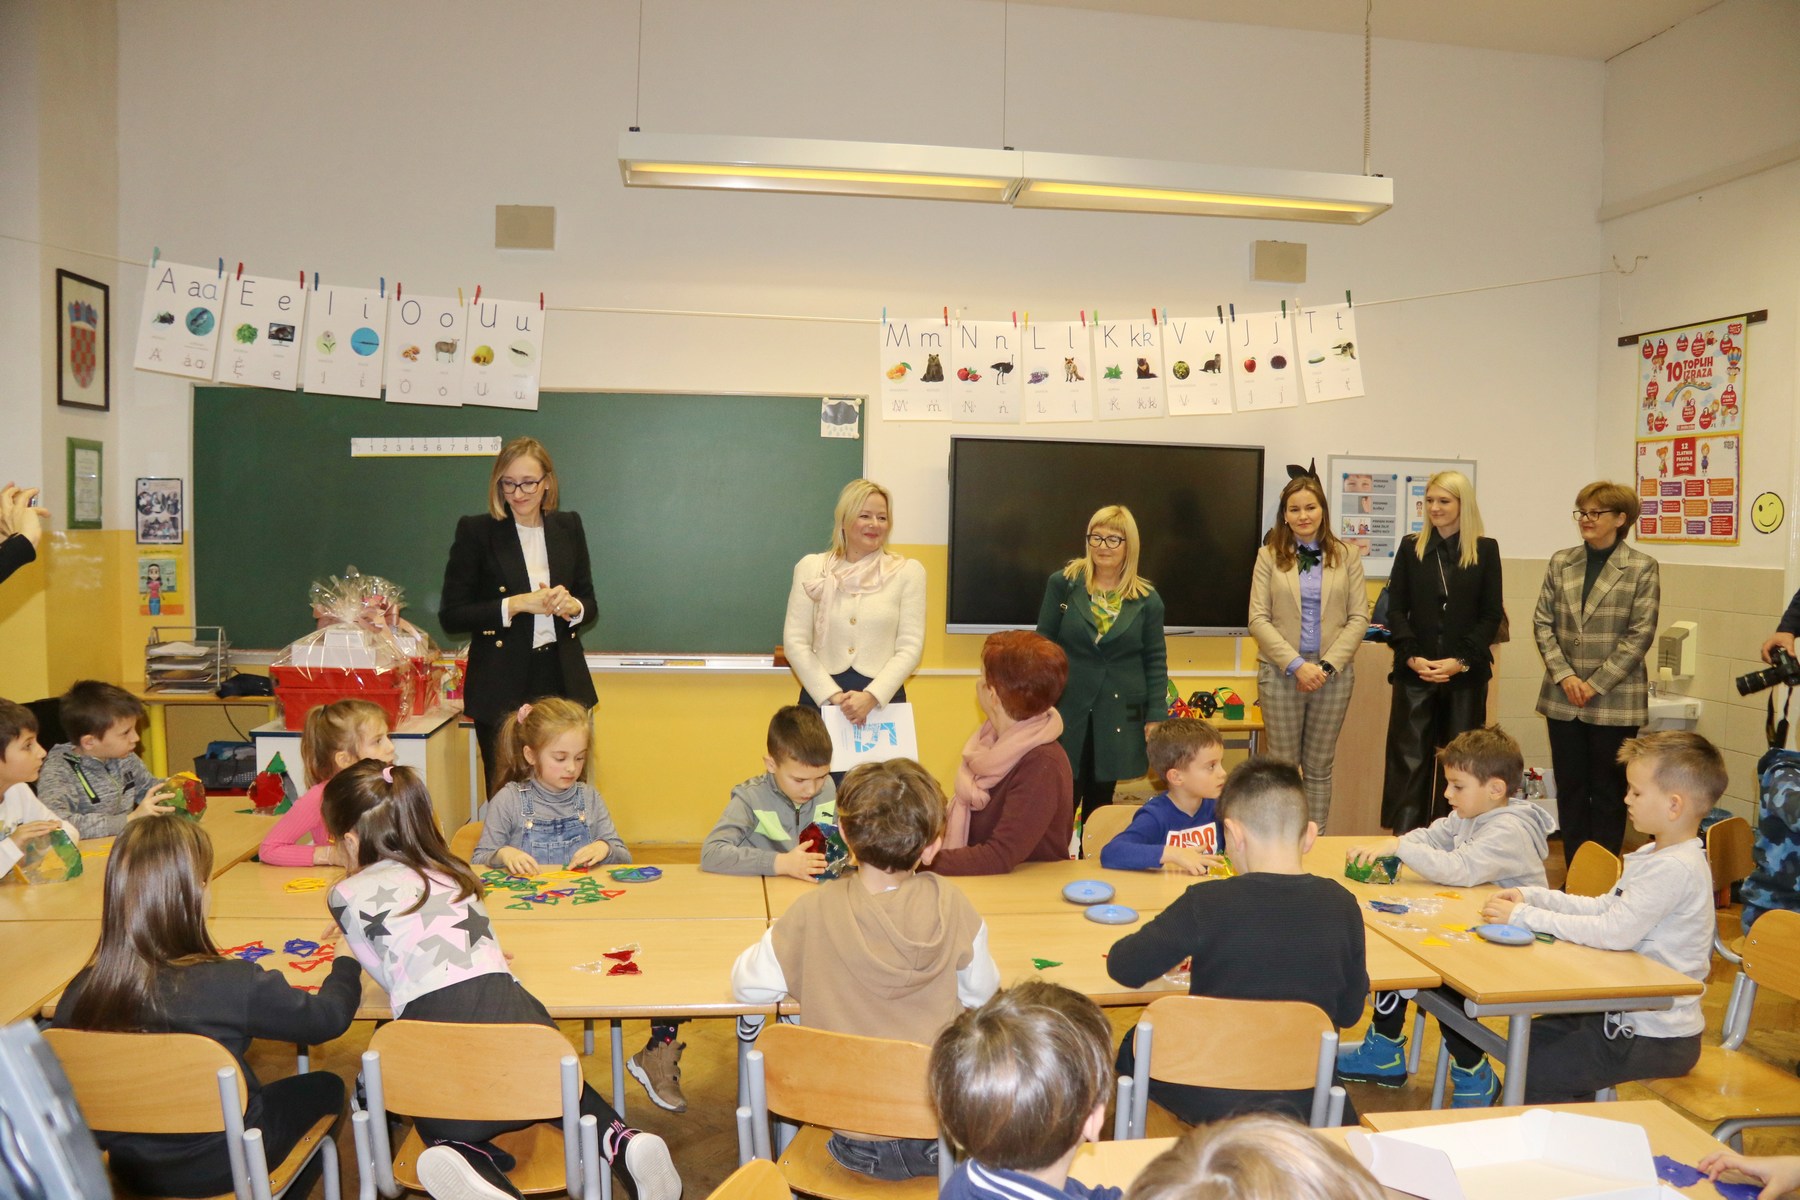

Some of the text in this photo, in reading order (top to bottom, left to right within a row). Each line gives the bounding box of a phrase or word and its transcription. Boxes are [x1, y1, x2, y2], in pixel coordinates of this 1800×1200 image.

[157, 267, 218, 300] A aa
[240, 280, 291, 310] E e
[364, 297, 368, 319] i
[402, 300, 454, 328] O o
[480, 302, 530, 331] U u
[1172, 322, 1214, 344] V v
[1244, 316, 1278, 346] J j
[1304, 311, 1343, 334] T t
[886, 323, 942, 347] M m
[962, 325, 1008, 349] N n
[1034, 326, 1046, 350] L
[1104, 324, 1154, 348] K kk
[1666, 356, 1714, 382] 10 TOPLIH
[1684, 368, 1712, 380] IZRAZA
